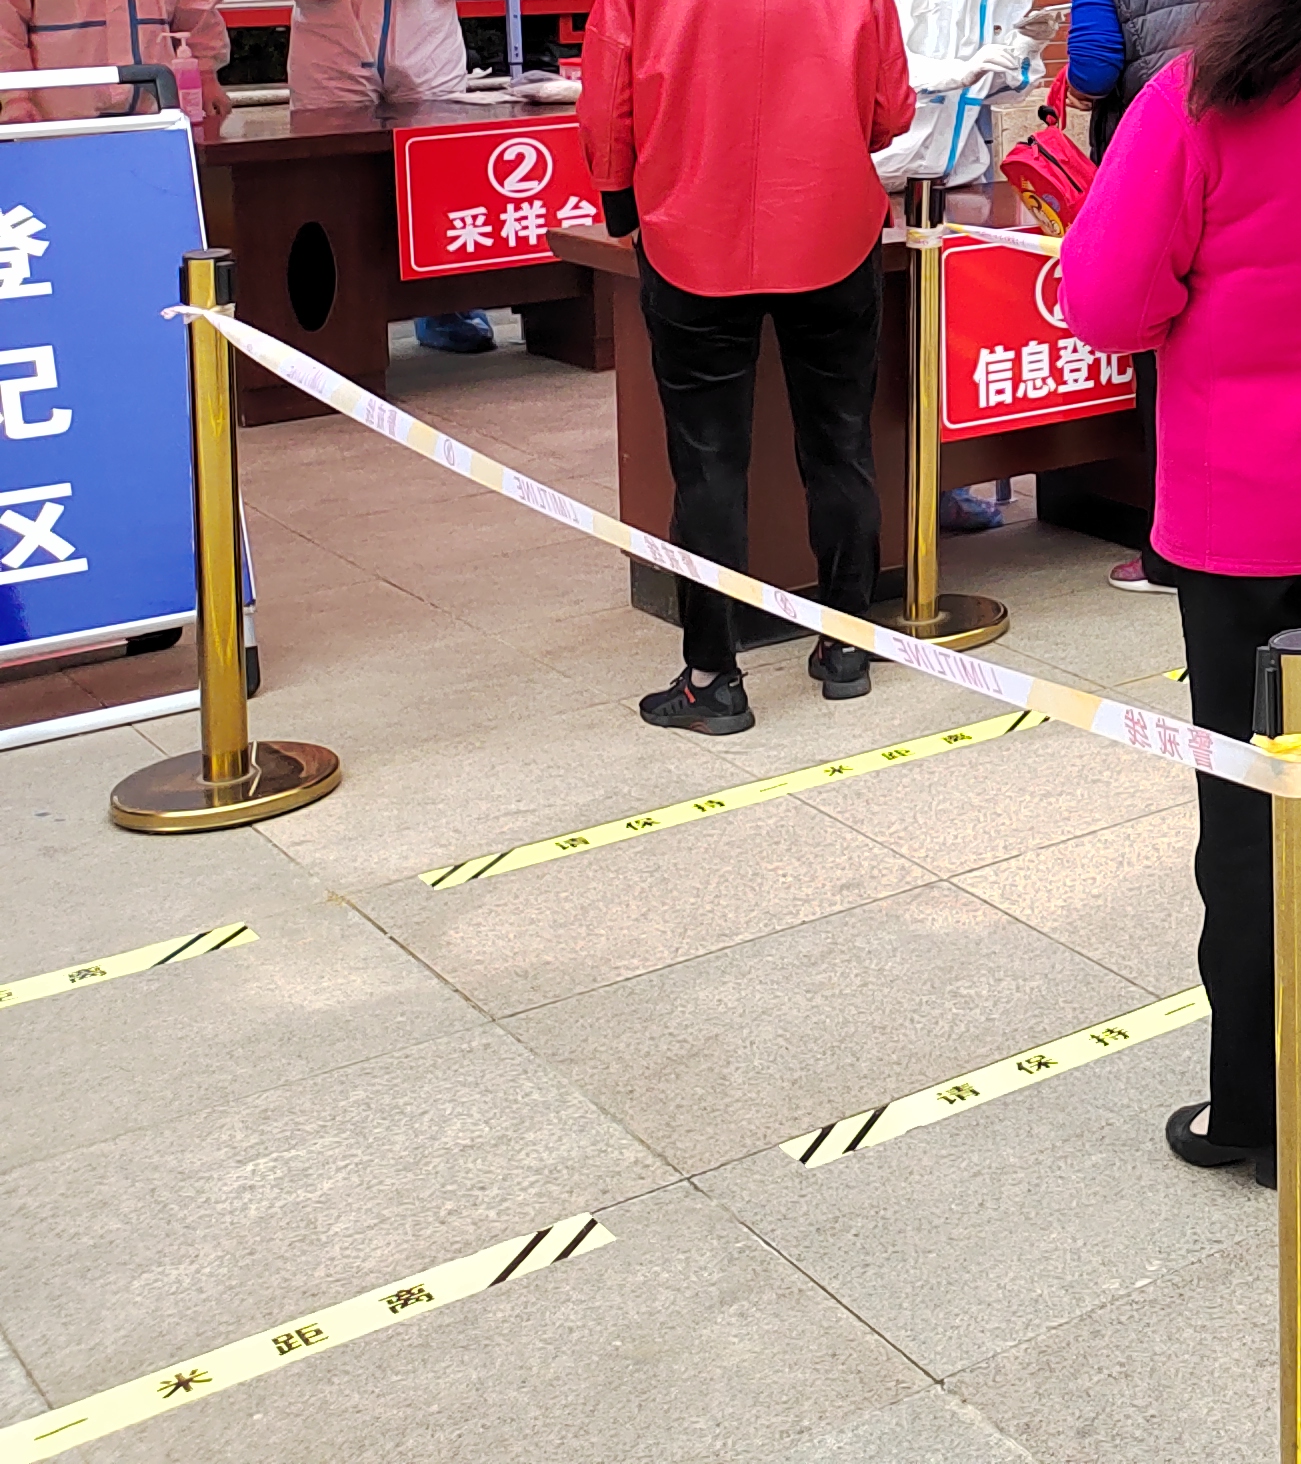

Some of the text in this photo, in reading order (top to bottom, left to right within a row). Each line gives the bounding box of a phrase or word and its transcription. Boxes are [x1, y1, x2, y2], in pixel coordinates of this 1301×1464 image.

[446, 196, 598, 253] 采样台
[973, 337, 1133, 408] 信息登记
[34, 1282, 434, 1440] 一米距离
